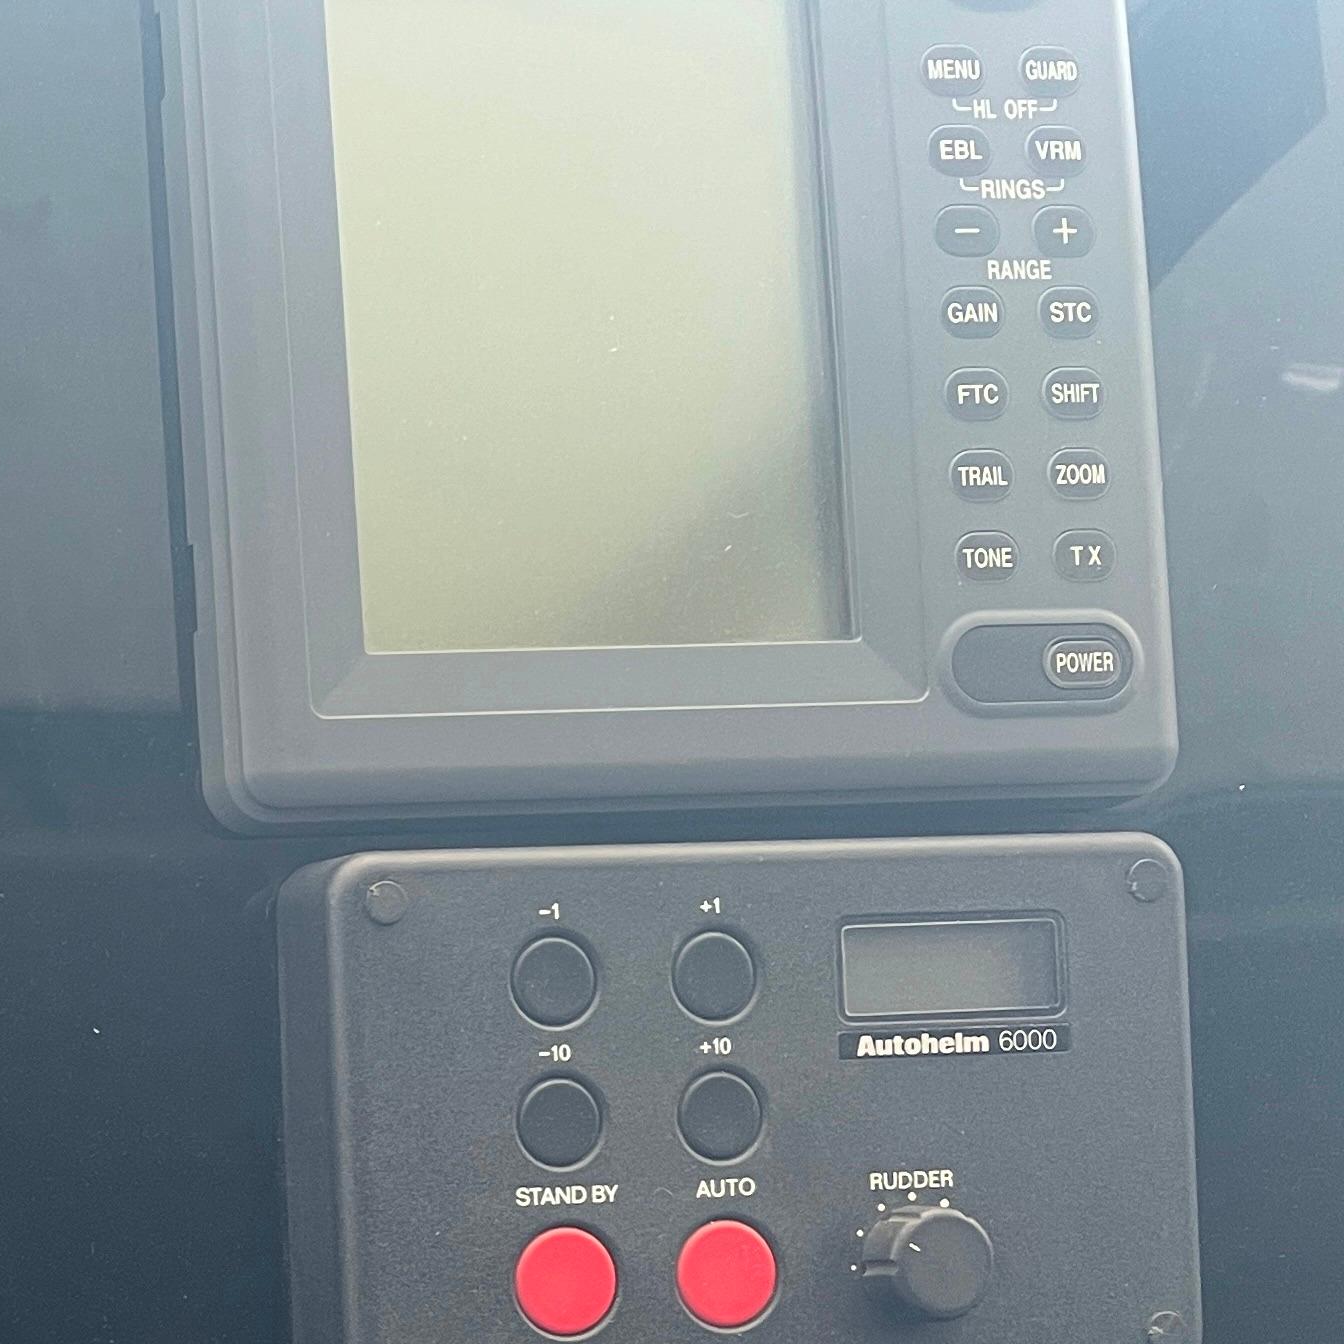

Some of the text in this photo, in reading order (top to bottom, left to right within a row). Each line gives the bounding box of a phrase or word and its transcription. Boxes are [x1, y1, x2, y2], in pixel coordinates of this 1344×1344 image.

[928, 59, 980, 80] MENU
[1025, 59, 1078, 81] GUARD
[973, 99, 1038, 119] HL OFF
[939, 140, 983, 160] EBL
[1035, 140, 1082, 161] VRM
[981, 179, 1046, 200] RINGS
[987, 260, 1052, 280] RANGE
[947, 302, 998, 323] GAIN
[1050, 302, 1092, 323] STC
[957, 384, 999, 404] FTC
[1051, 383, 1099, 404] SHIFT
[958, 466, 1008, 486] TRAIL
[1055, 464, 1105, 485] ZOOM
[963, 548, 1013, 568] TONE
[1056, 652, 1113, 672] POWER
[539, 903, 560, 920] -1
[700, 897, 720, 914] +1
[538, 1044, 571, 1062] -10
[699, 1037, 731, 1055] +10
[856, 1030, 1057, 1058] Autohelm 6000
[696, 1178, 755, 1199] AUTO
[869, 1169, 953, 1191] RUDDER
[516, 1184, 619, 1206] STAND BY
